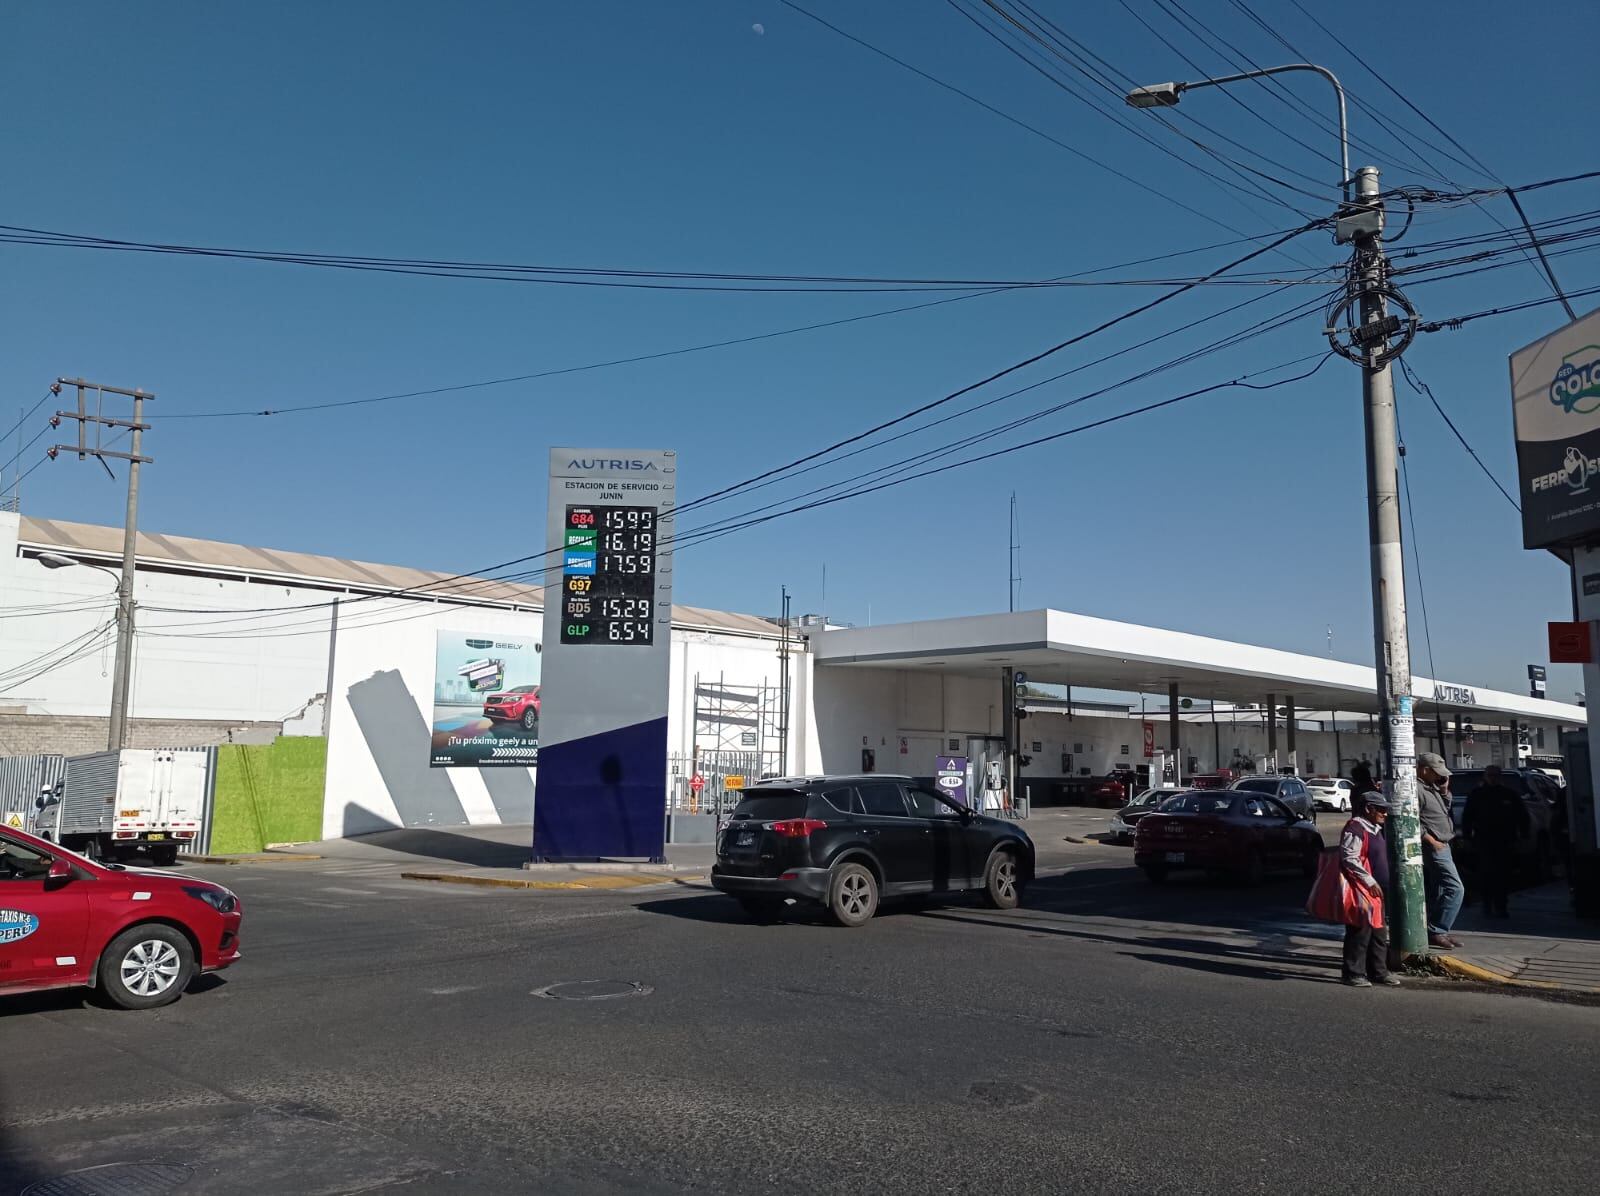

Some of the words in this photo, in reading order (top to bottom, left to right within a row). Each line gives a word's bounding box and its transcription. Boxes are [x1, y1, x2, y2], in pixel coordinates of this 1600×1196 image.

[1558, 367, 1573, 378] RED
[568, 459, 658, 470] AUTRISA
[565, 481, 604, 490] ESTACION
[608, 482, 618, 490] DE
[621, 483, 659, 491] SERVICIO
[600, 492, 623, 500] JUNIN
[571, 513, 594, 525] G84
[605, 533, 652, 551] 16.19
[604, 555, 651, 573] 17.59
[569, 580, 592, 591] G97
[567, 602, 591, 613] BD5
[602, 600, 649, 618] 15.29
[567, 624, 590, 636] GLP
[609, 622, 649, 640] 6.54
[1433, 684, 1476, 704] AUTRISA
[448, 737, 462, 746] ¡Tu
[463, 737, 498, 747] próximo
[499, 737, 520, 747] geely
